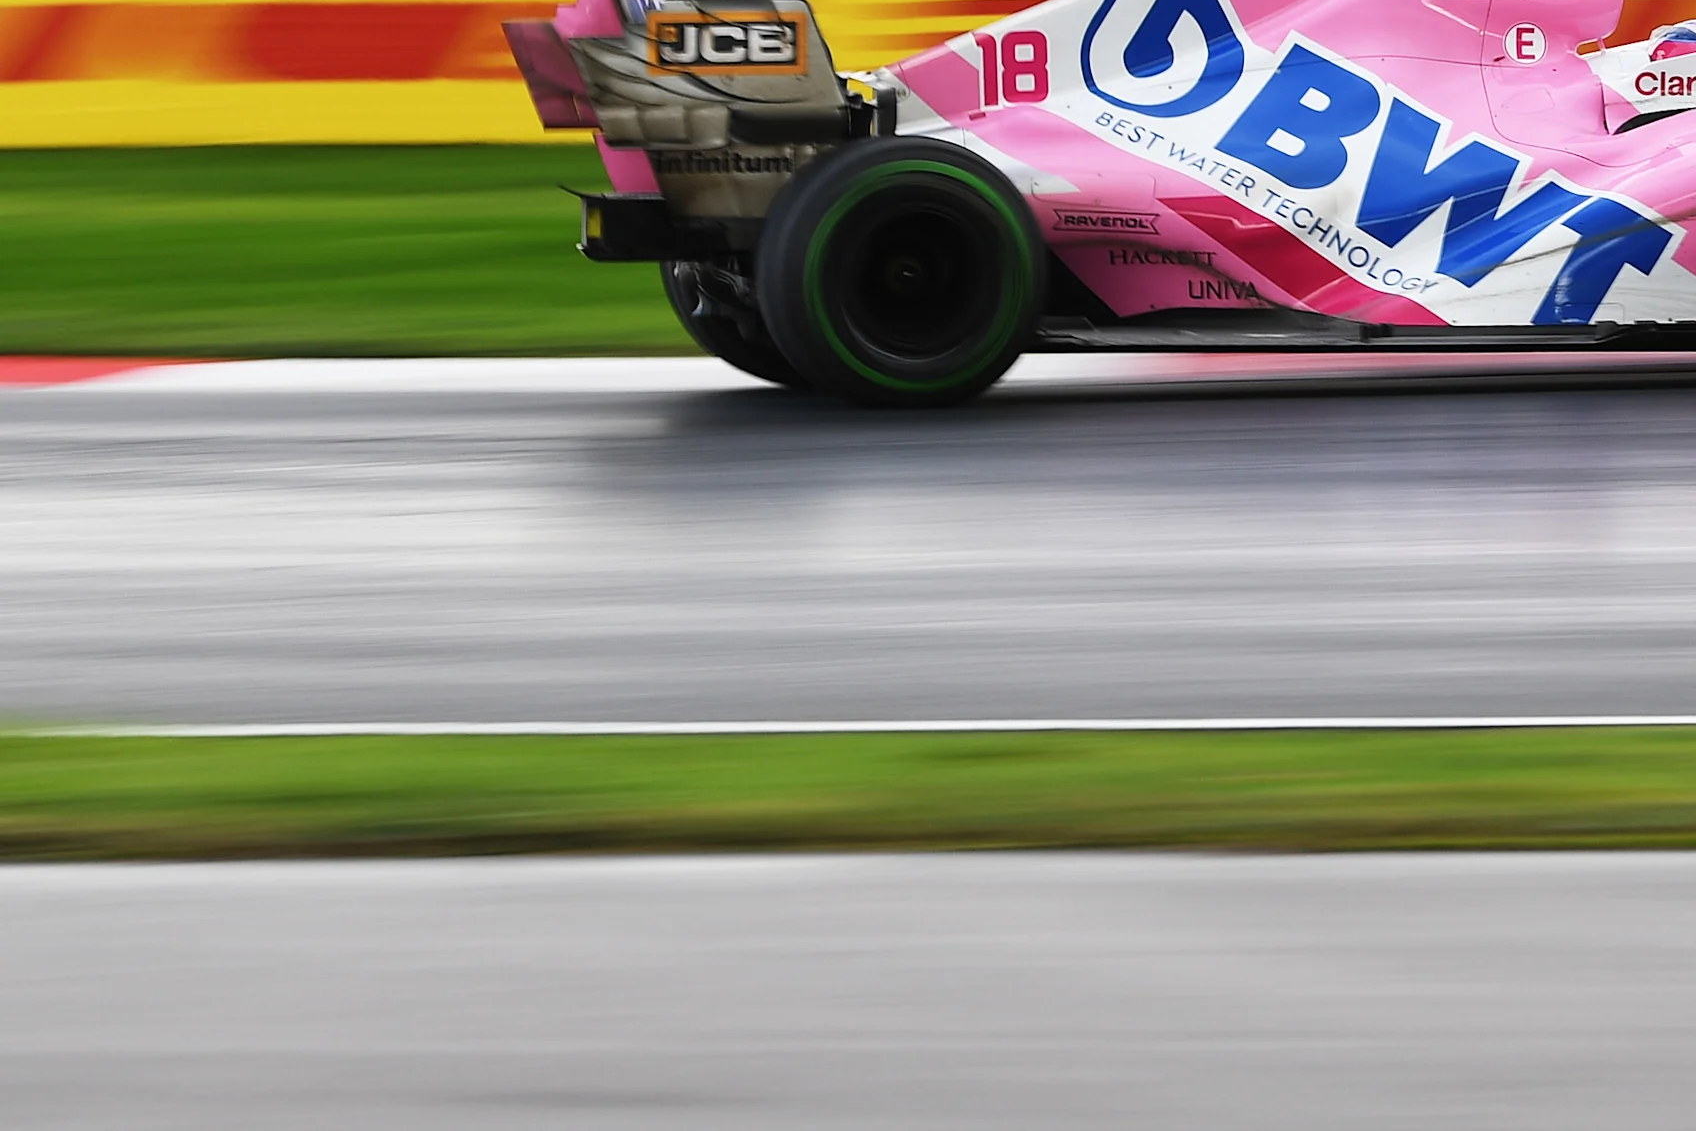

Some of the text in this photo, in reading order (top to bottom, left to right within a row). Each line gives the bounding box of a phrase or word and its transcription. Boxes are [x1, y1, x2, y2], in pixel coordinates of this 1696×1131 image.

[659, 24, 795, 64] JCB
[1515, 26, 1536, 61] E
[976, 31, 1049, 107] 18
[1214, 41, 1674, 326] BWT
[1062, 214, 1151, 230] RAVENOL
[1094, 111, 1441, 296] BEST WATER TECHNOLOGY
[1108, 249, 1218, 267] HACKETT
[1188, 280, 1262, 300] UNIVA
